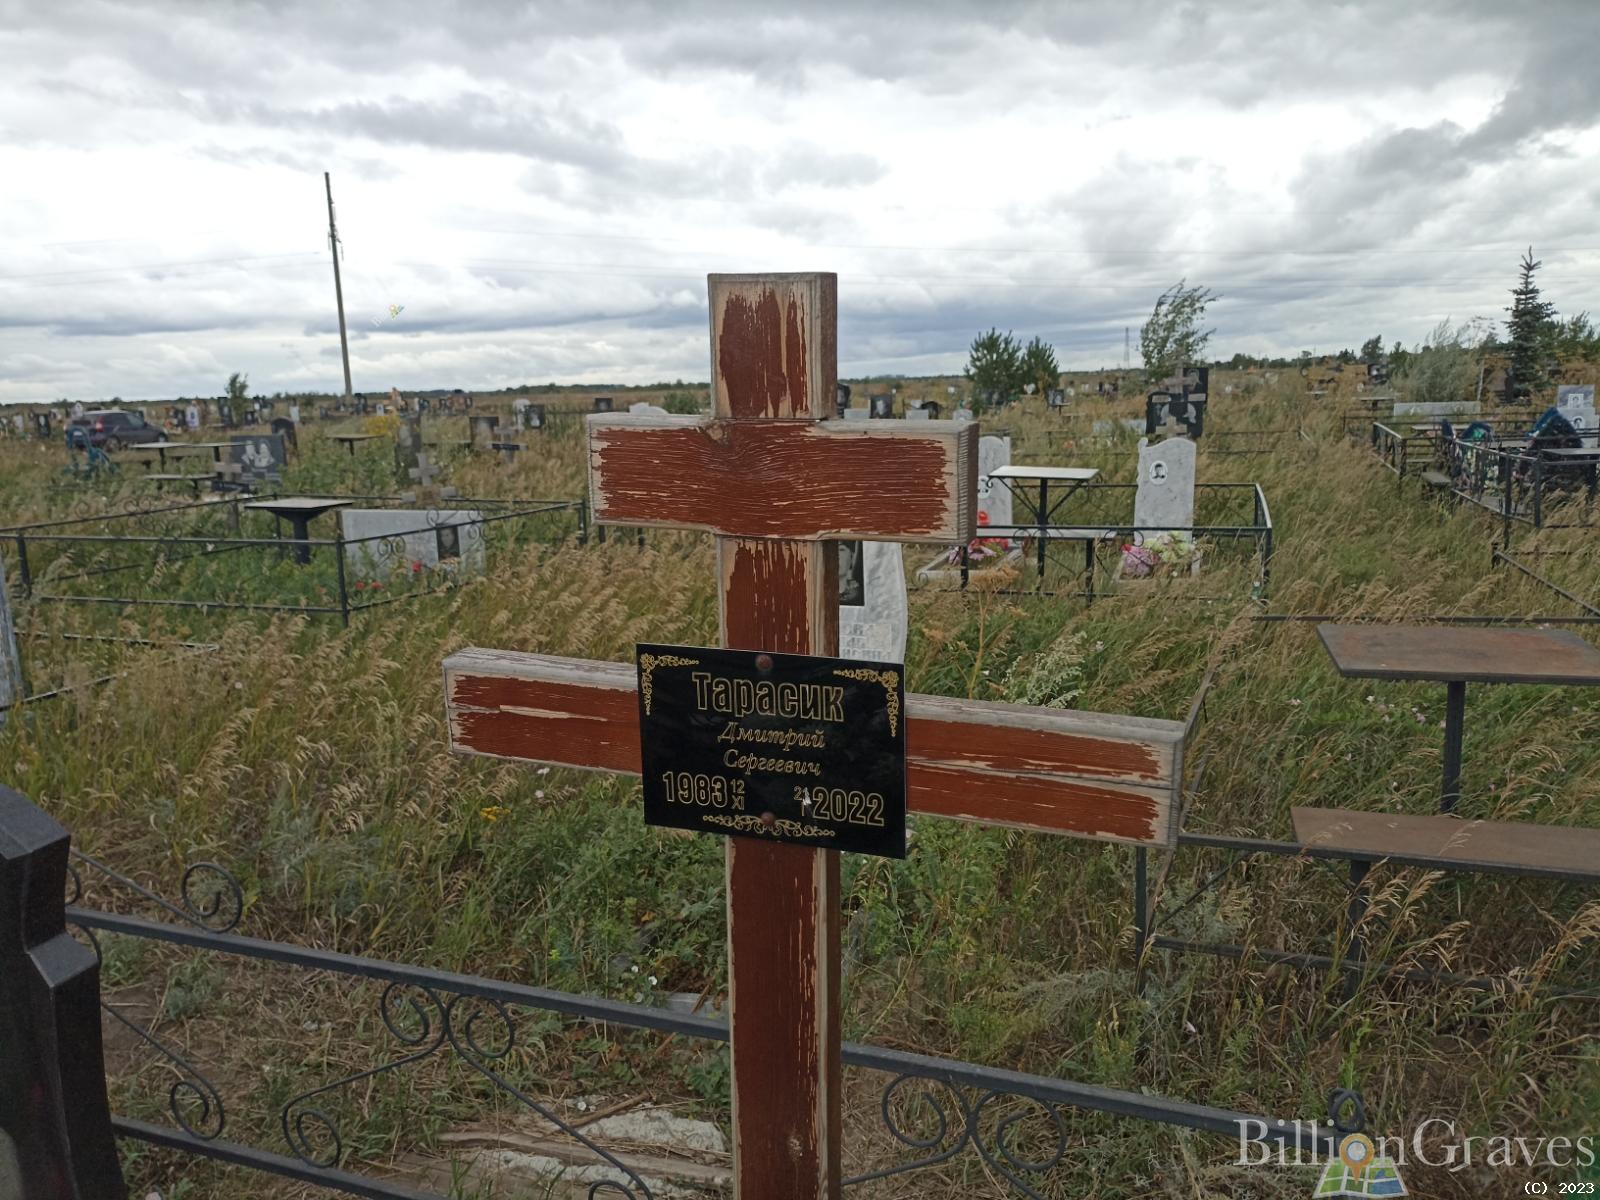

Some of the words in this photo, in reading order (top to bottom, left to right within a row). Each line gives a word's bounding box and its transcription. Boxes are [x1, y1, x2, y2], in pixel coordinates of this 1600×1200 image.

[691, 672, 844, 722] Тарасик
[717, 721, 826, 751] Дмитрий
[723, 749, 821, 775] Сергеевич
[662, 771, 727, 807] 1983
[730, 779, 745, 794] 12
[812, 786, 885, 826] 2022
